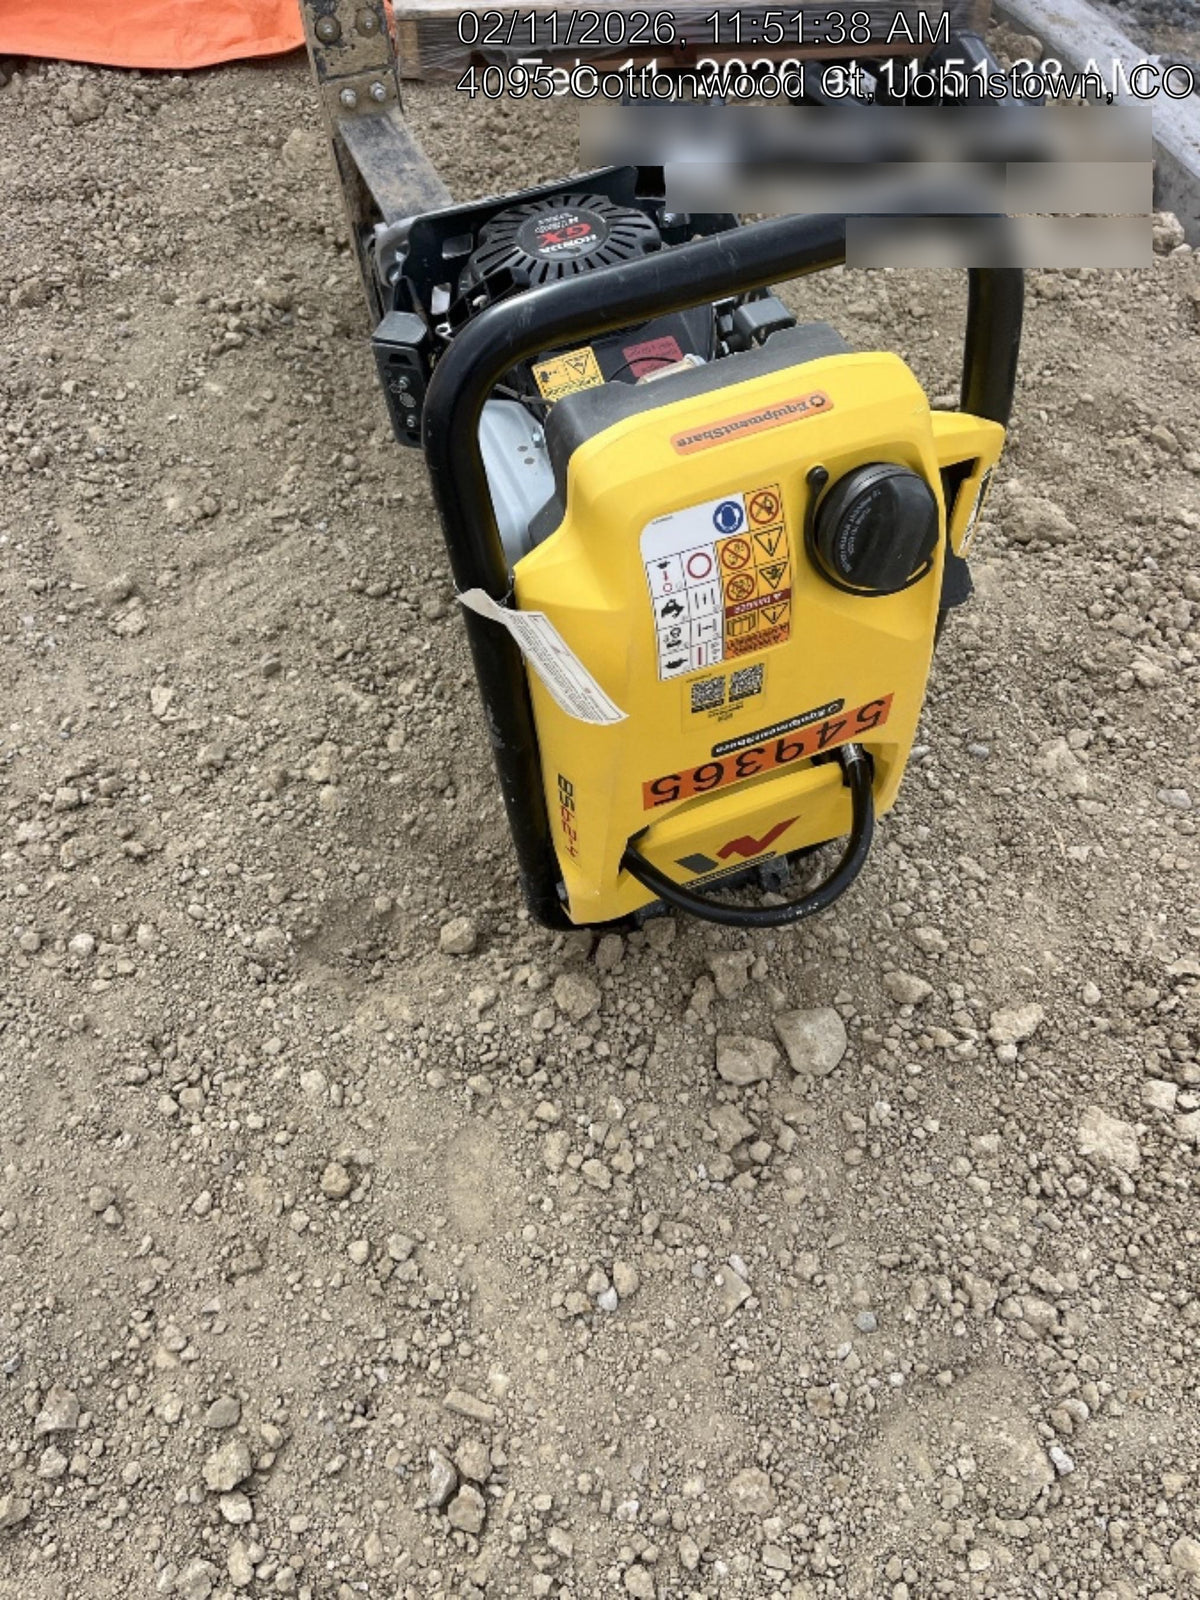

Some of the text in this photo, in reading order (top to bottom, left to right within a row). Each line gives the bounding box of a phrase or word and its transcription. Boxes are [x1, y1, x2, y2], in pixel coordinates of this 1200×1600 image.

[536, 222, 592, 249] GX
[538, 234, 598, 254] HONDA
[676, 401, 811, 448] EquipmentShare
[651, 699, 887, 807] 549365
